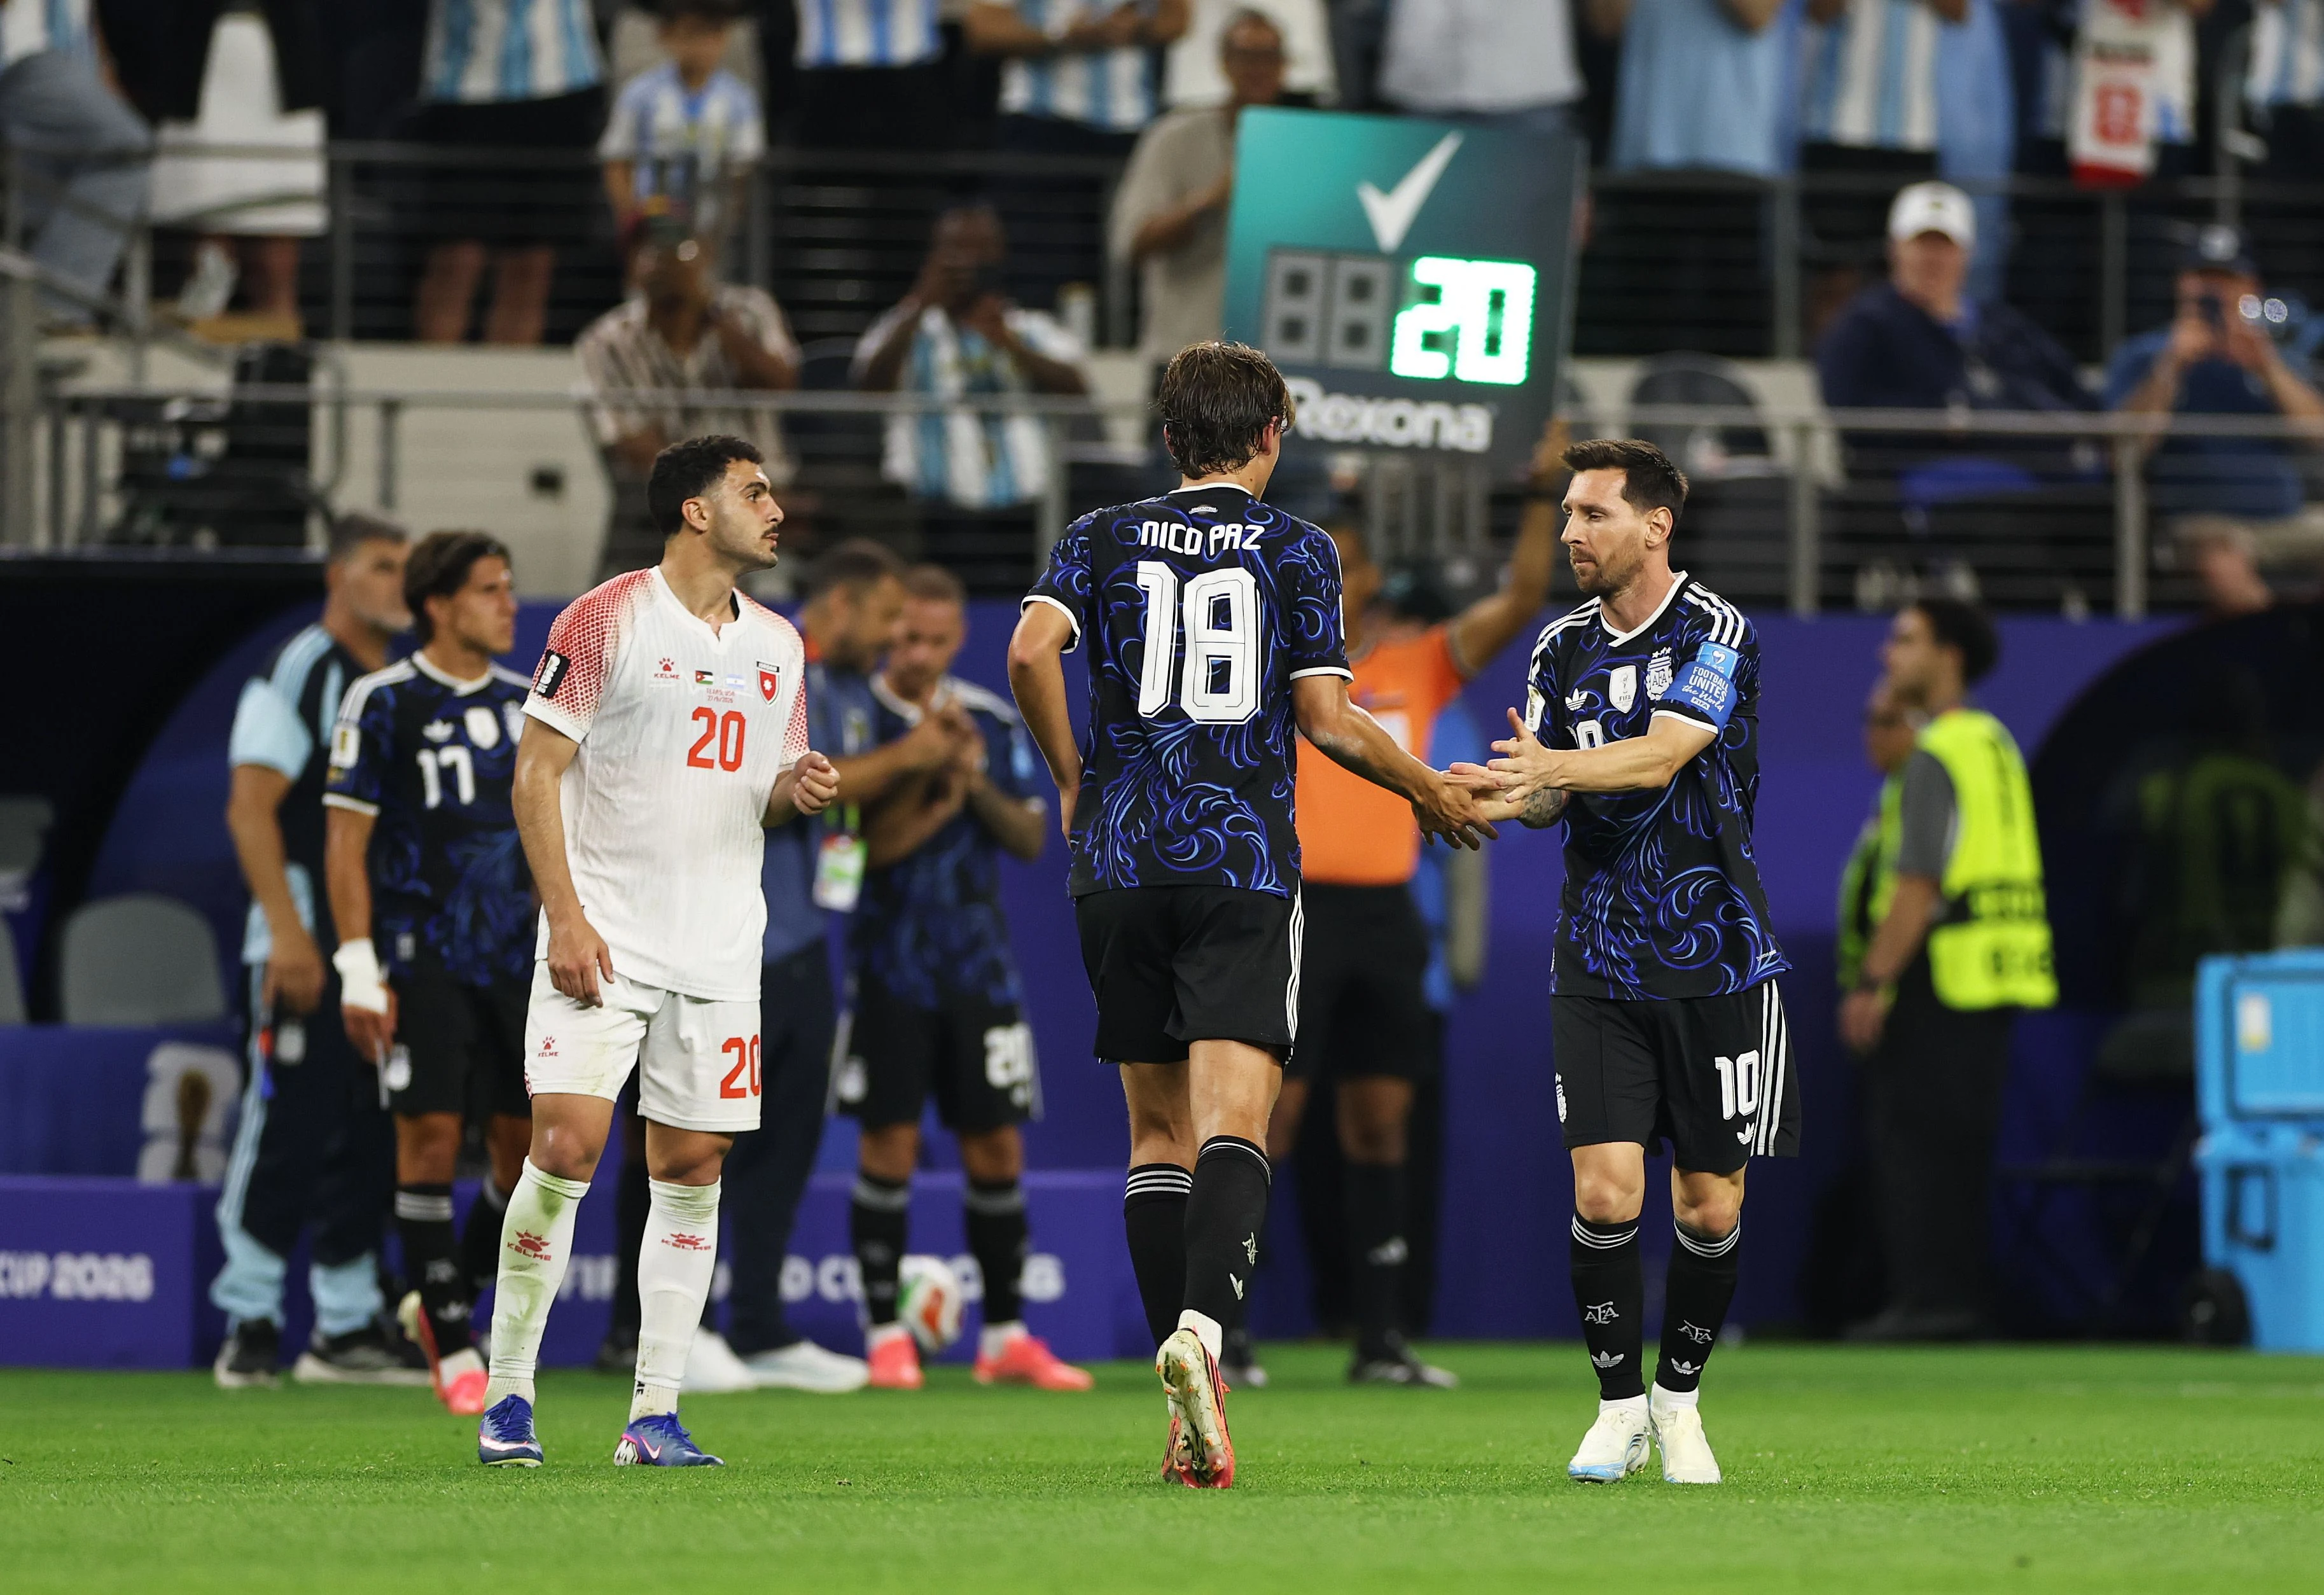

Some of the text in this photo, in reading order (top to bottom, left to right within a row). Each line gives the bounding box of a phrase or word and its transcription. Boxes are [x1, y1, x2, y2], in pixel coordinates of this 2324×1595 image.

[1391, 256, 1536, 384] 20
[1281, 377, 1491, 453] Rexona
[1140, 521, 1265, 557] NICO PAZ
[1137, 561, 1262, 725] 18
[1681, 685, 1725, 713] the World
[1688, 674, 1727, 702] UNITES
[1693, 666, 1729, 693] FOOTBALL
[687, 706, 746, 772] 20
[415, 747, 476, 809] 17
[720, 1034, 761, 1099] 20
[1715, 1048, 1760, 1120] 10
[1584, 1301, 1620, 1324] AFA
[1677, 1319, 1713, 1344] AFA
